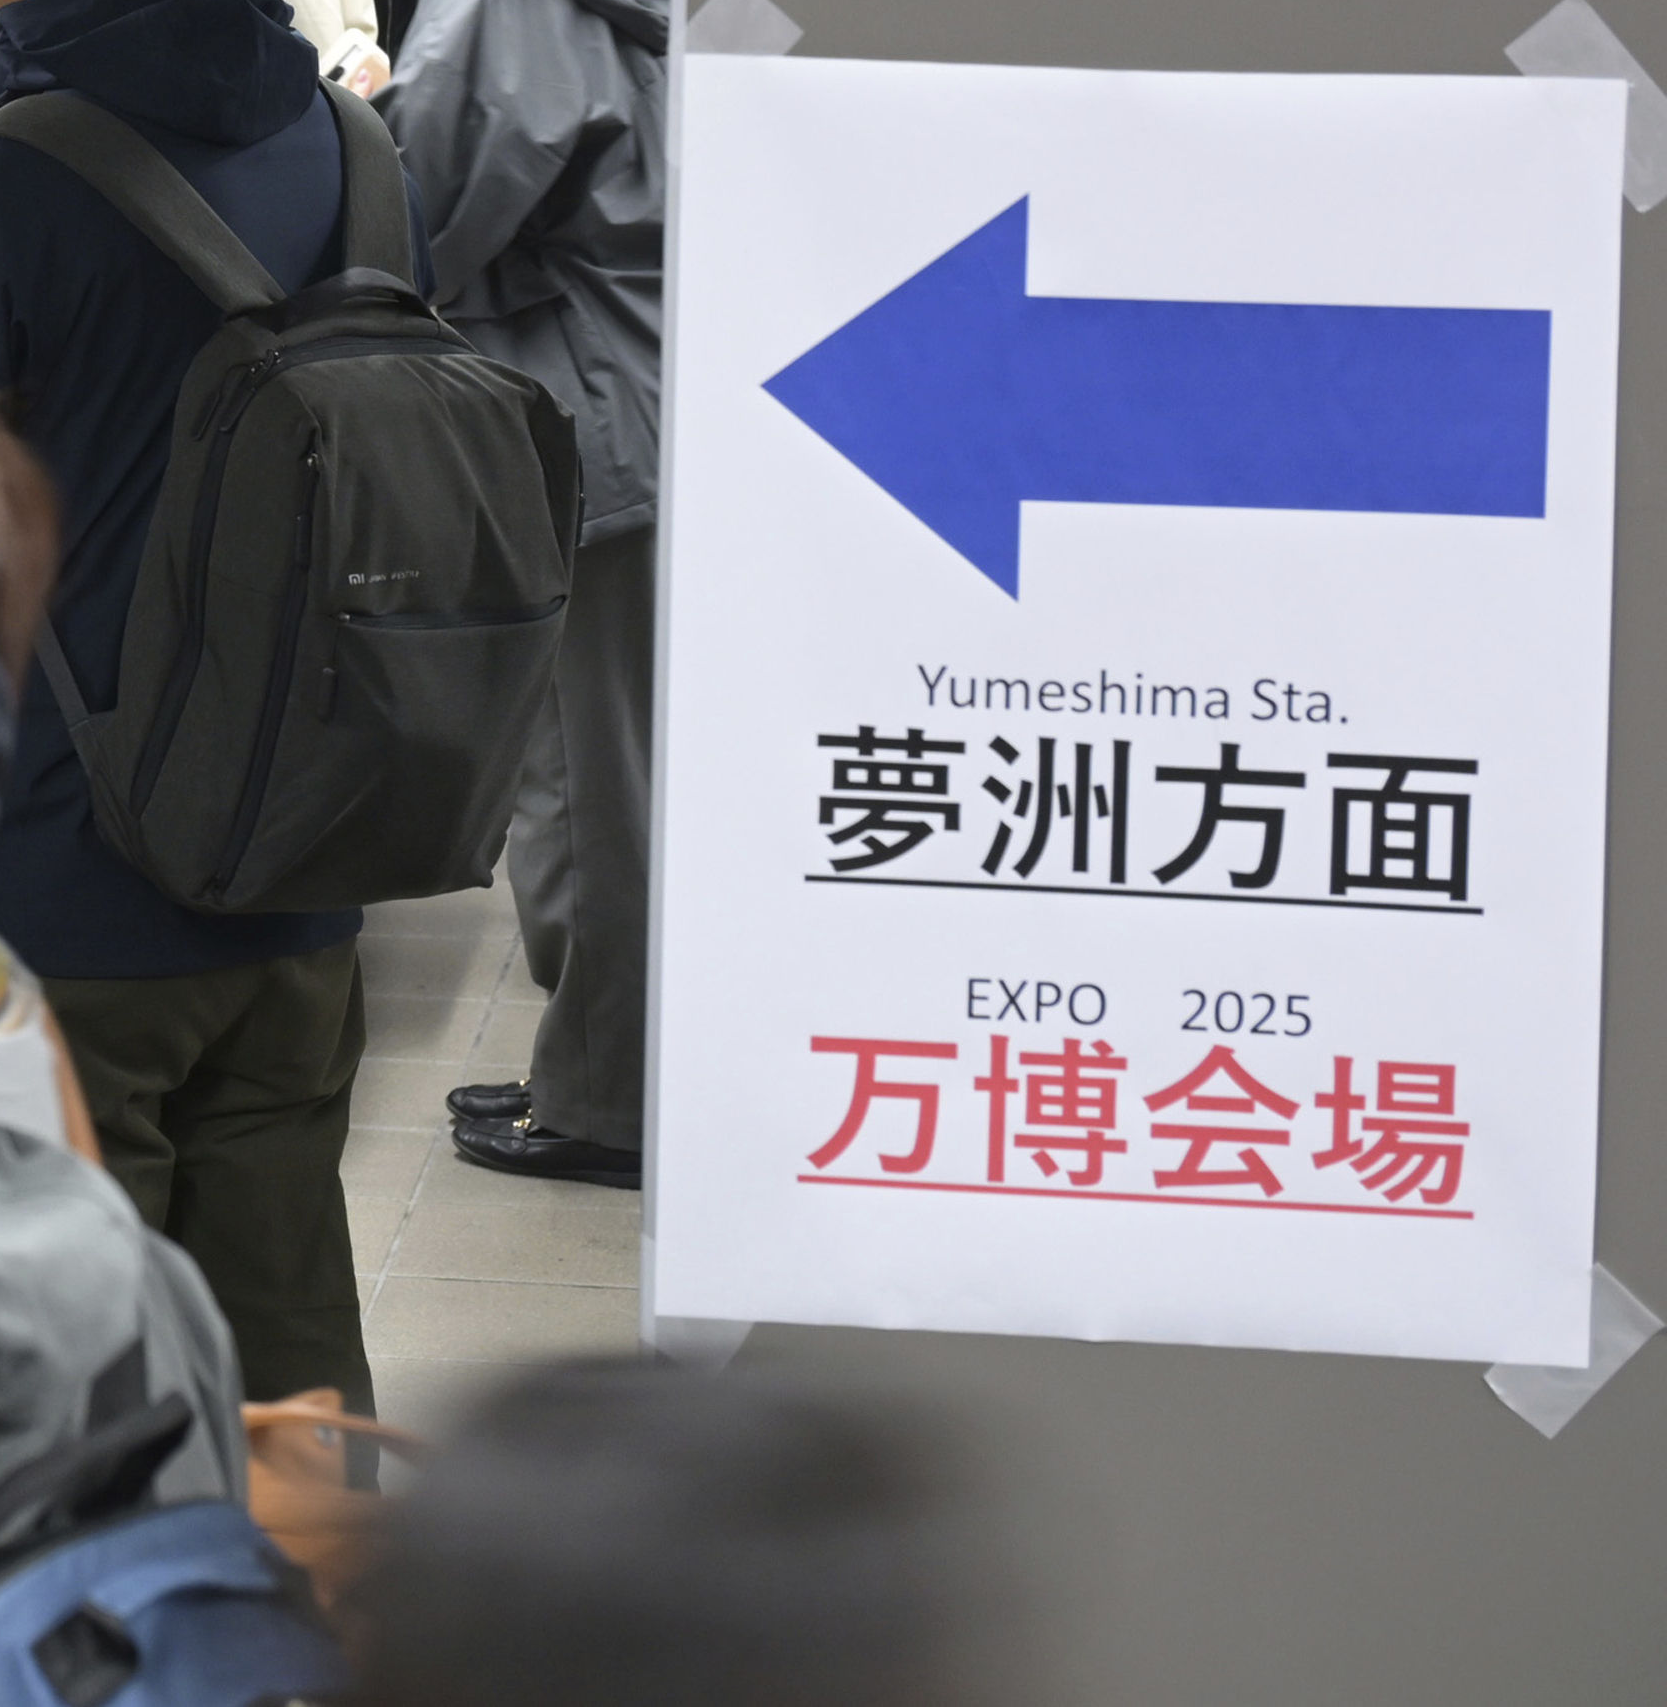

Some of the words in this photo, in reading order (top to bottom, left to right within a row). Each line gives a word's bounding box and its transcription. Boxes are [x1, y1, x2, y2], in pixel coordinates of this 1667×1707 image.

[917, 663, 1232, 721] Yumeshima
[1251, 678, 1350, 726] Sta.
[816, 724, 1480, 902] 夢洲方面
[966, 977, 1108, 1027] EXPO
[1179, 988, 1314, 1039] 2025
[805, 1034, 1471, 1206] 万博会場
